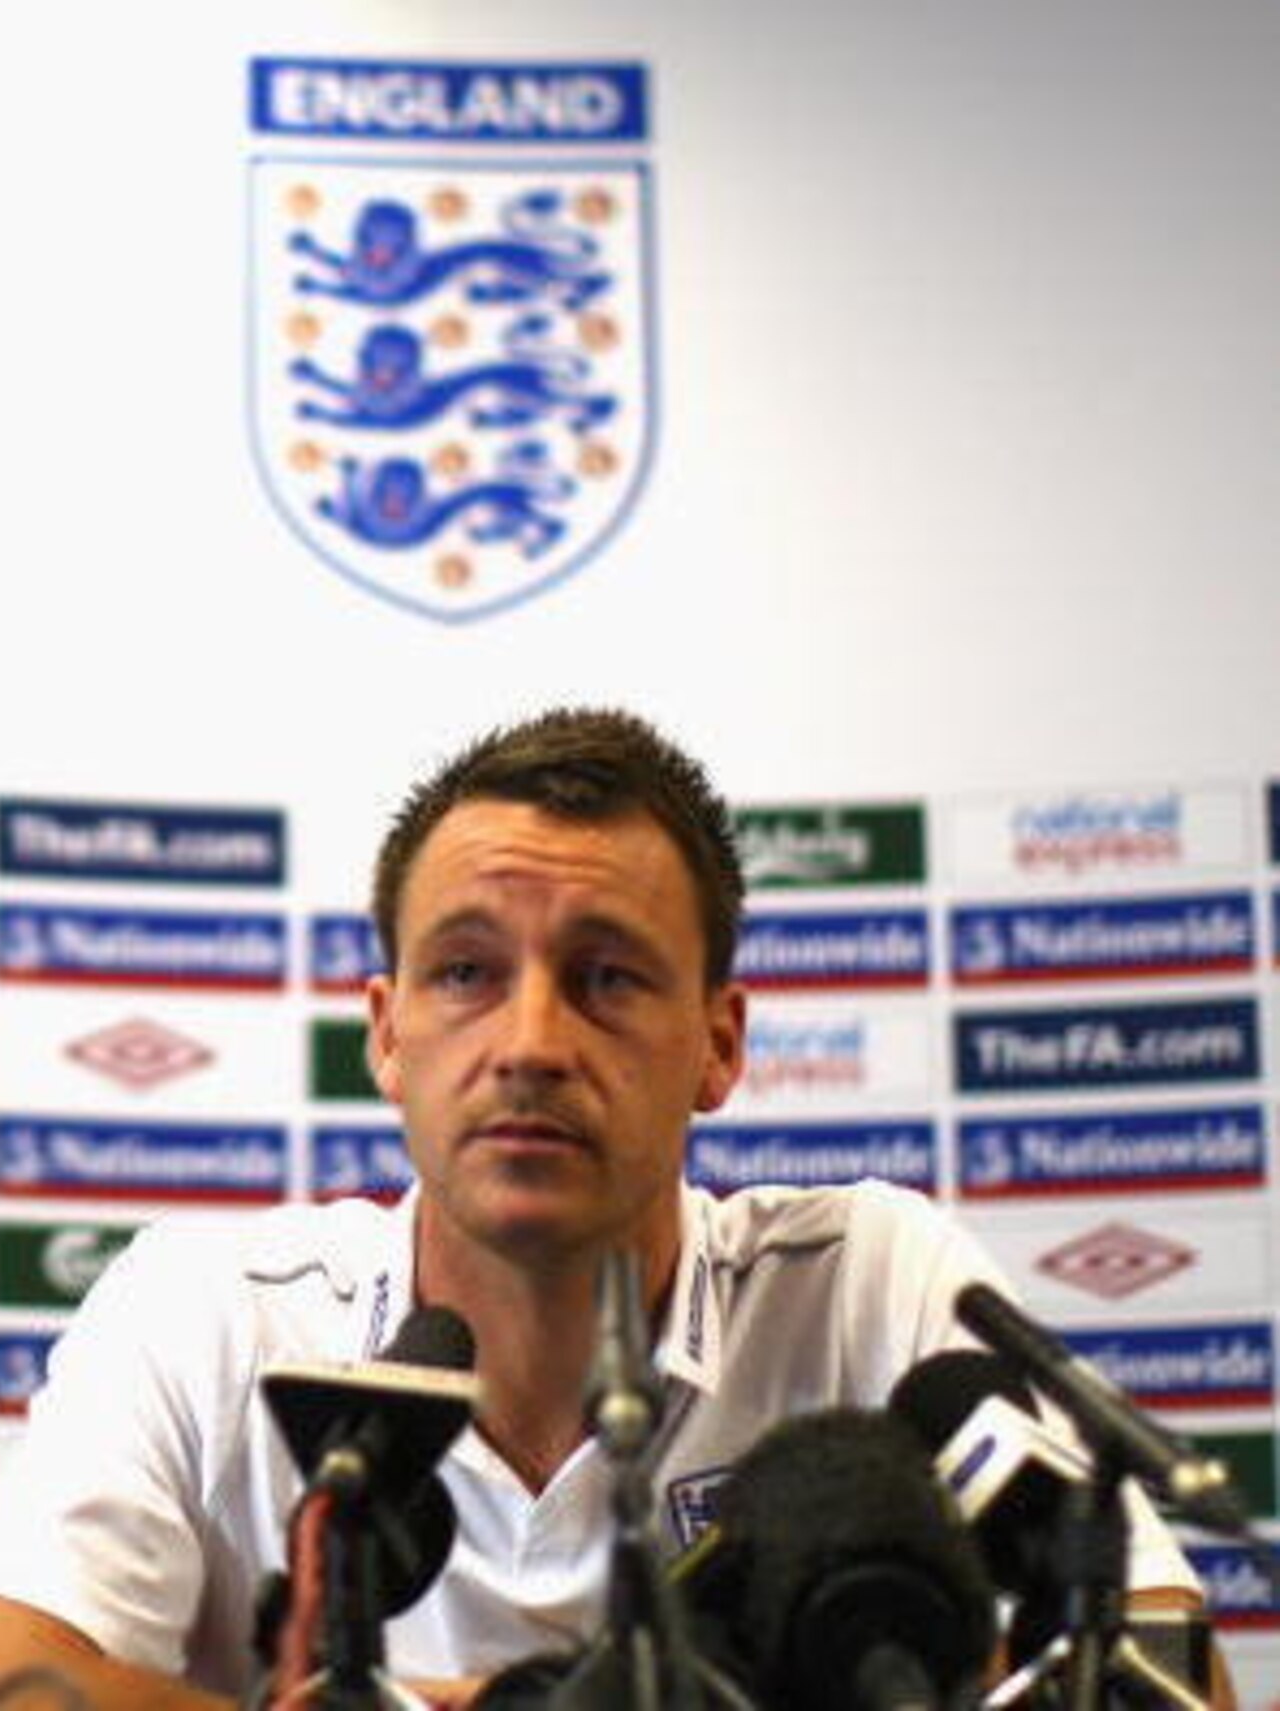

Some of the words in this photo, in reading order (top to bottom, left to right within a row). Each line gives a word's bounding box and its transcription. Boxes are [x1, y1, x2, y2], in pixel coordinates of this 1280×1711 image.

[271, 67, 624, 130] ENGLAND
[1013, 789, 1181, 833] national
[1015, 829, 1181, 872] express
[48, 919, 283, 971] Nationwide
[1011, 908, 1247, 962] Nationwide
[48, 1132, 283, 1183] Nationwide
[691, 1134, 929, 1183] Nationwide
[1024, 1119, 1259, 1175] Nationwide
